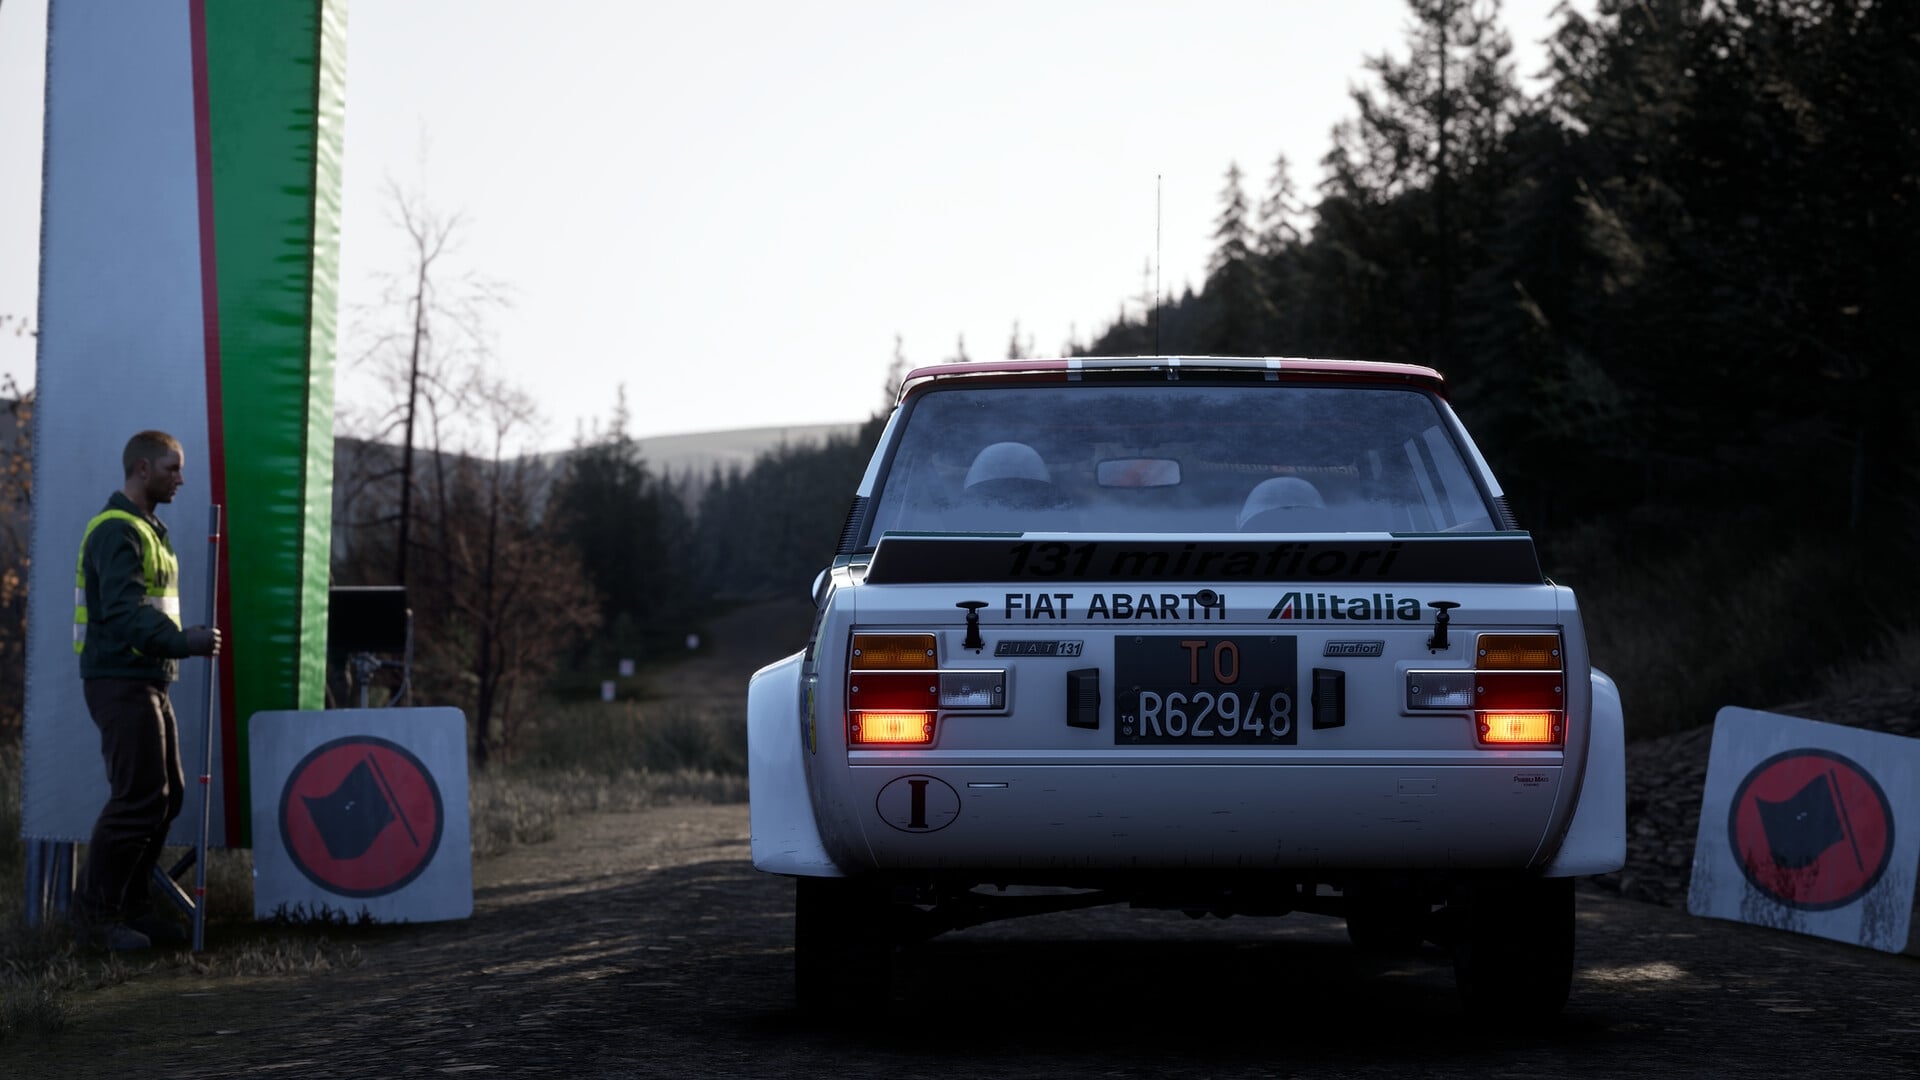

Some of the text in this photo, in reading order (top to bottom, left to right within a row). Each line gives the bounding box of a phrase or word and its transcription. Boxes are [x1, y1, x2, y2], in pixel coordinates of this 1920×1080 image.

[1008, 541, 1402, 577] 131 mirafiori
[1005, 593, 1226, 620] FIAT ABARTH
[1267, 592, 1421, 620] Alitalia
[1000, 642, 1081, 654] FIAT 131
[1181, 640, 1239, 684] TO
[1328, 643, 1379, 654] mirafiori
[1121, 715, 1135, 724] TO
[1139, 691, 1292, 737] R62948
[908, 780, 929, 829] I
